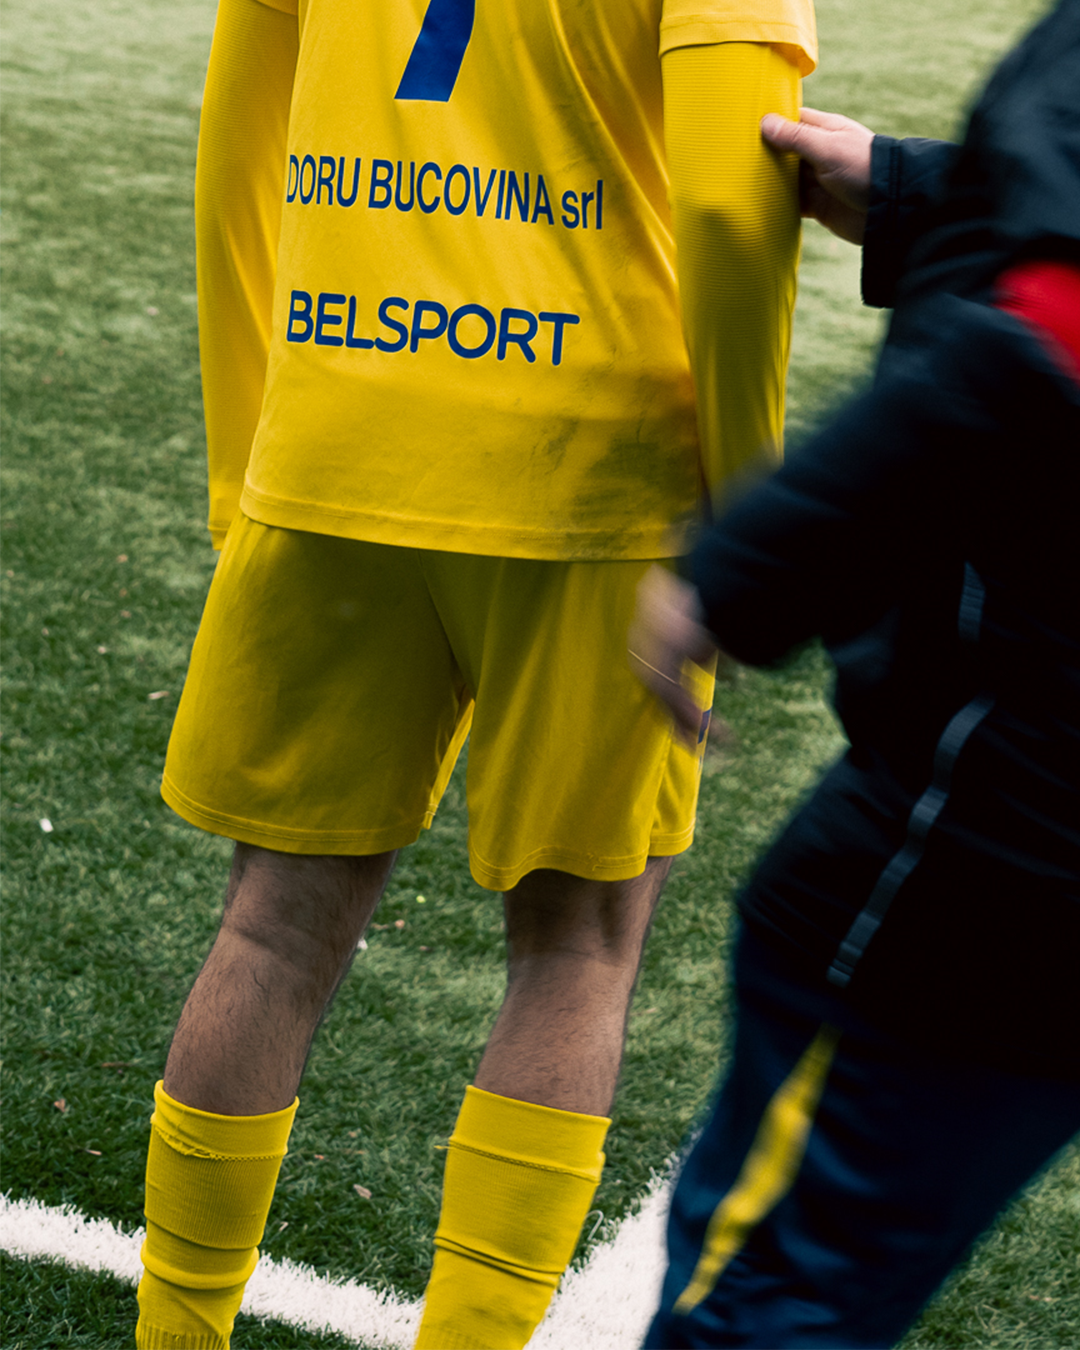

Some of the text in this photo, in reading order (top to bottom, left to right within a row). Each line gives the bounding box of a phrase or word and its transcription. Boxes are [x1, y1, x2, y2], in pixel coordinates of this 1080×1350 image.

[286, 154, 604, 230] DORU BUCOVINA srl
[286, 289, 581, 366] BELSPORT
